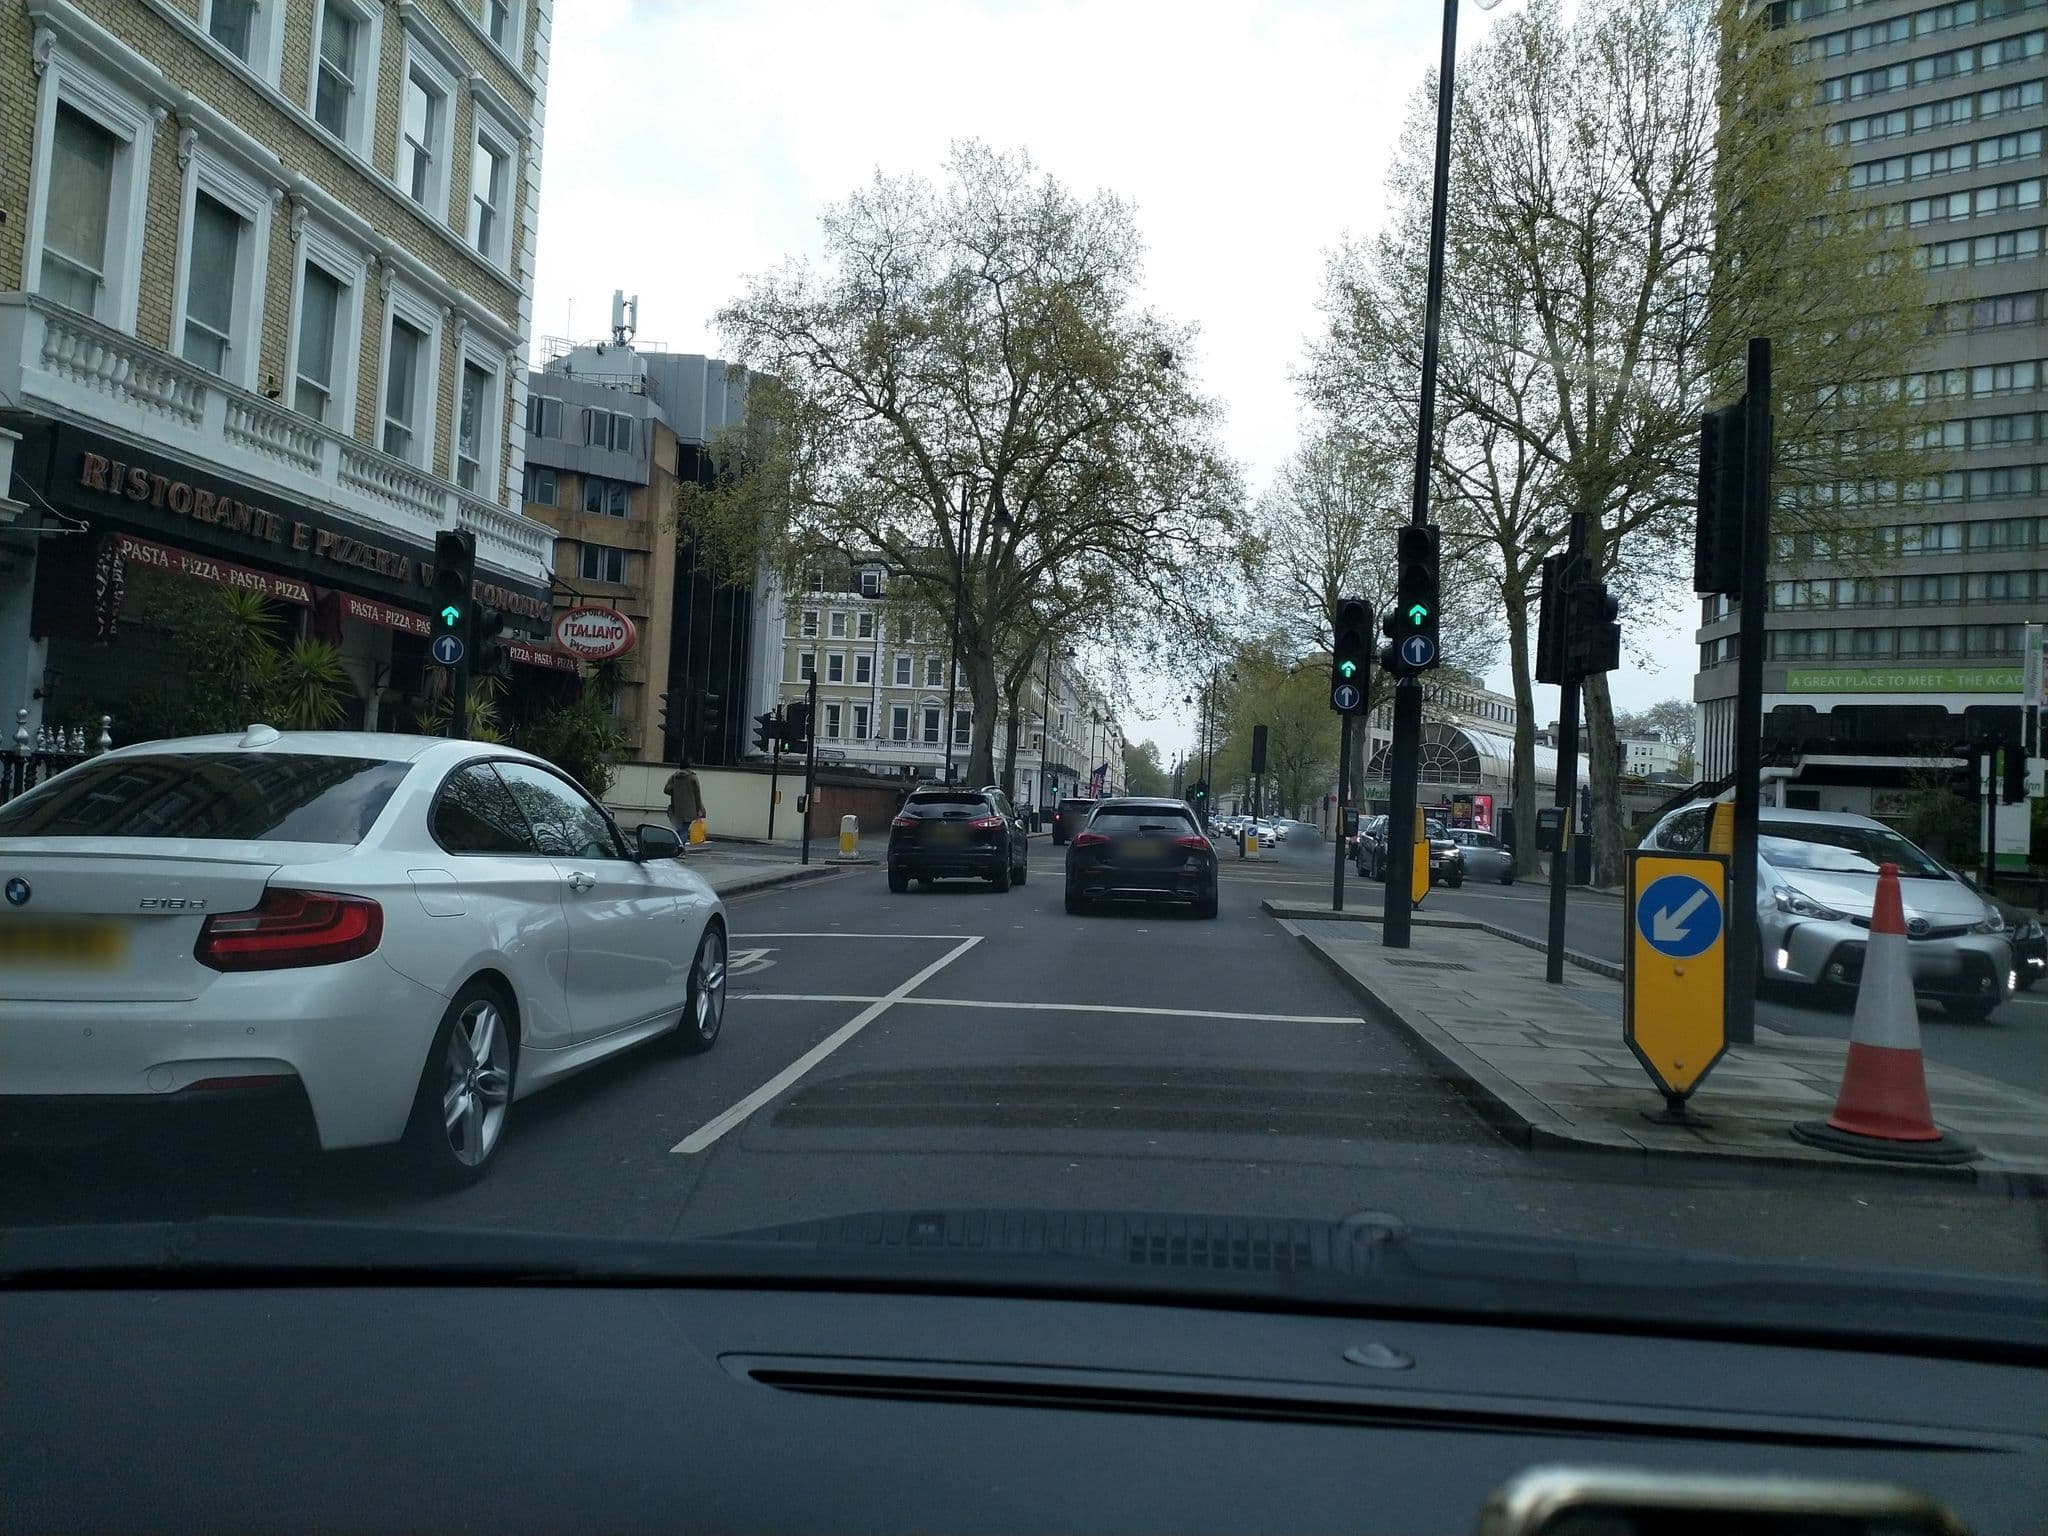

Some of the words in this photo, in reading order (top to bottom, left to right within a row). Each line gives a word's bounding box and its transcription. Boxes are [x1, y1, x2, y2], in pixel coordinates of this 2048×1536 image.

[81, 452, 284, 543] RISTORANTE
[292, 520, 311, 551] E
[314, 527, 410, 581] PIZZERIA
[123, 540, 169, 567] PASTA
[181, 556, 220, 581] PIZZA
[229, 569, 268, 592] PASTA
[275, 580, 310, 602] PIZZA
[350, 599, 379, 621] PASTA
[386, 610, 411, 629] PIZZA
[564, 623, 624, 640] ITALIANO
[509, 647, 530, 662] PIZZA
[534, 652, 553, 665] PASTA
[570, 638, 616, 656] PIZZERIA
[1791, 677, 1800, 687] A
[1804, 676, 1841, 687] GREAT
[1846, 675, 1885, 687] PLACE
[1887, 675, 1905, 686] TO
[1908, 674, 1945, 686] MEET
[1957, 674, 1983, 686] THE
